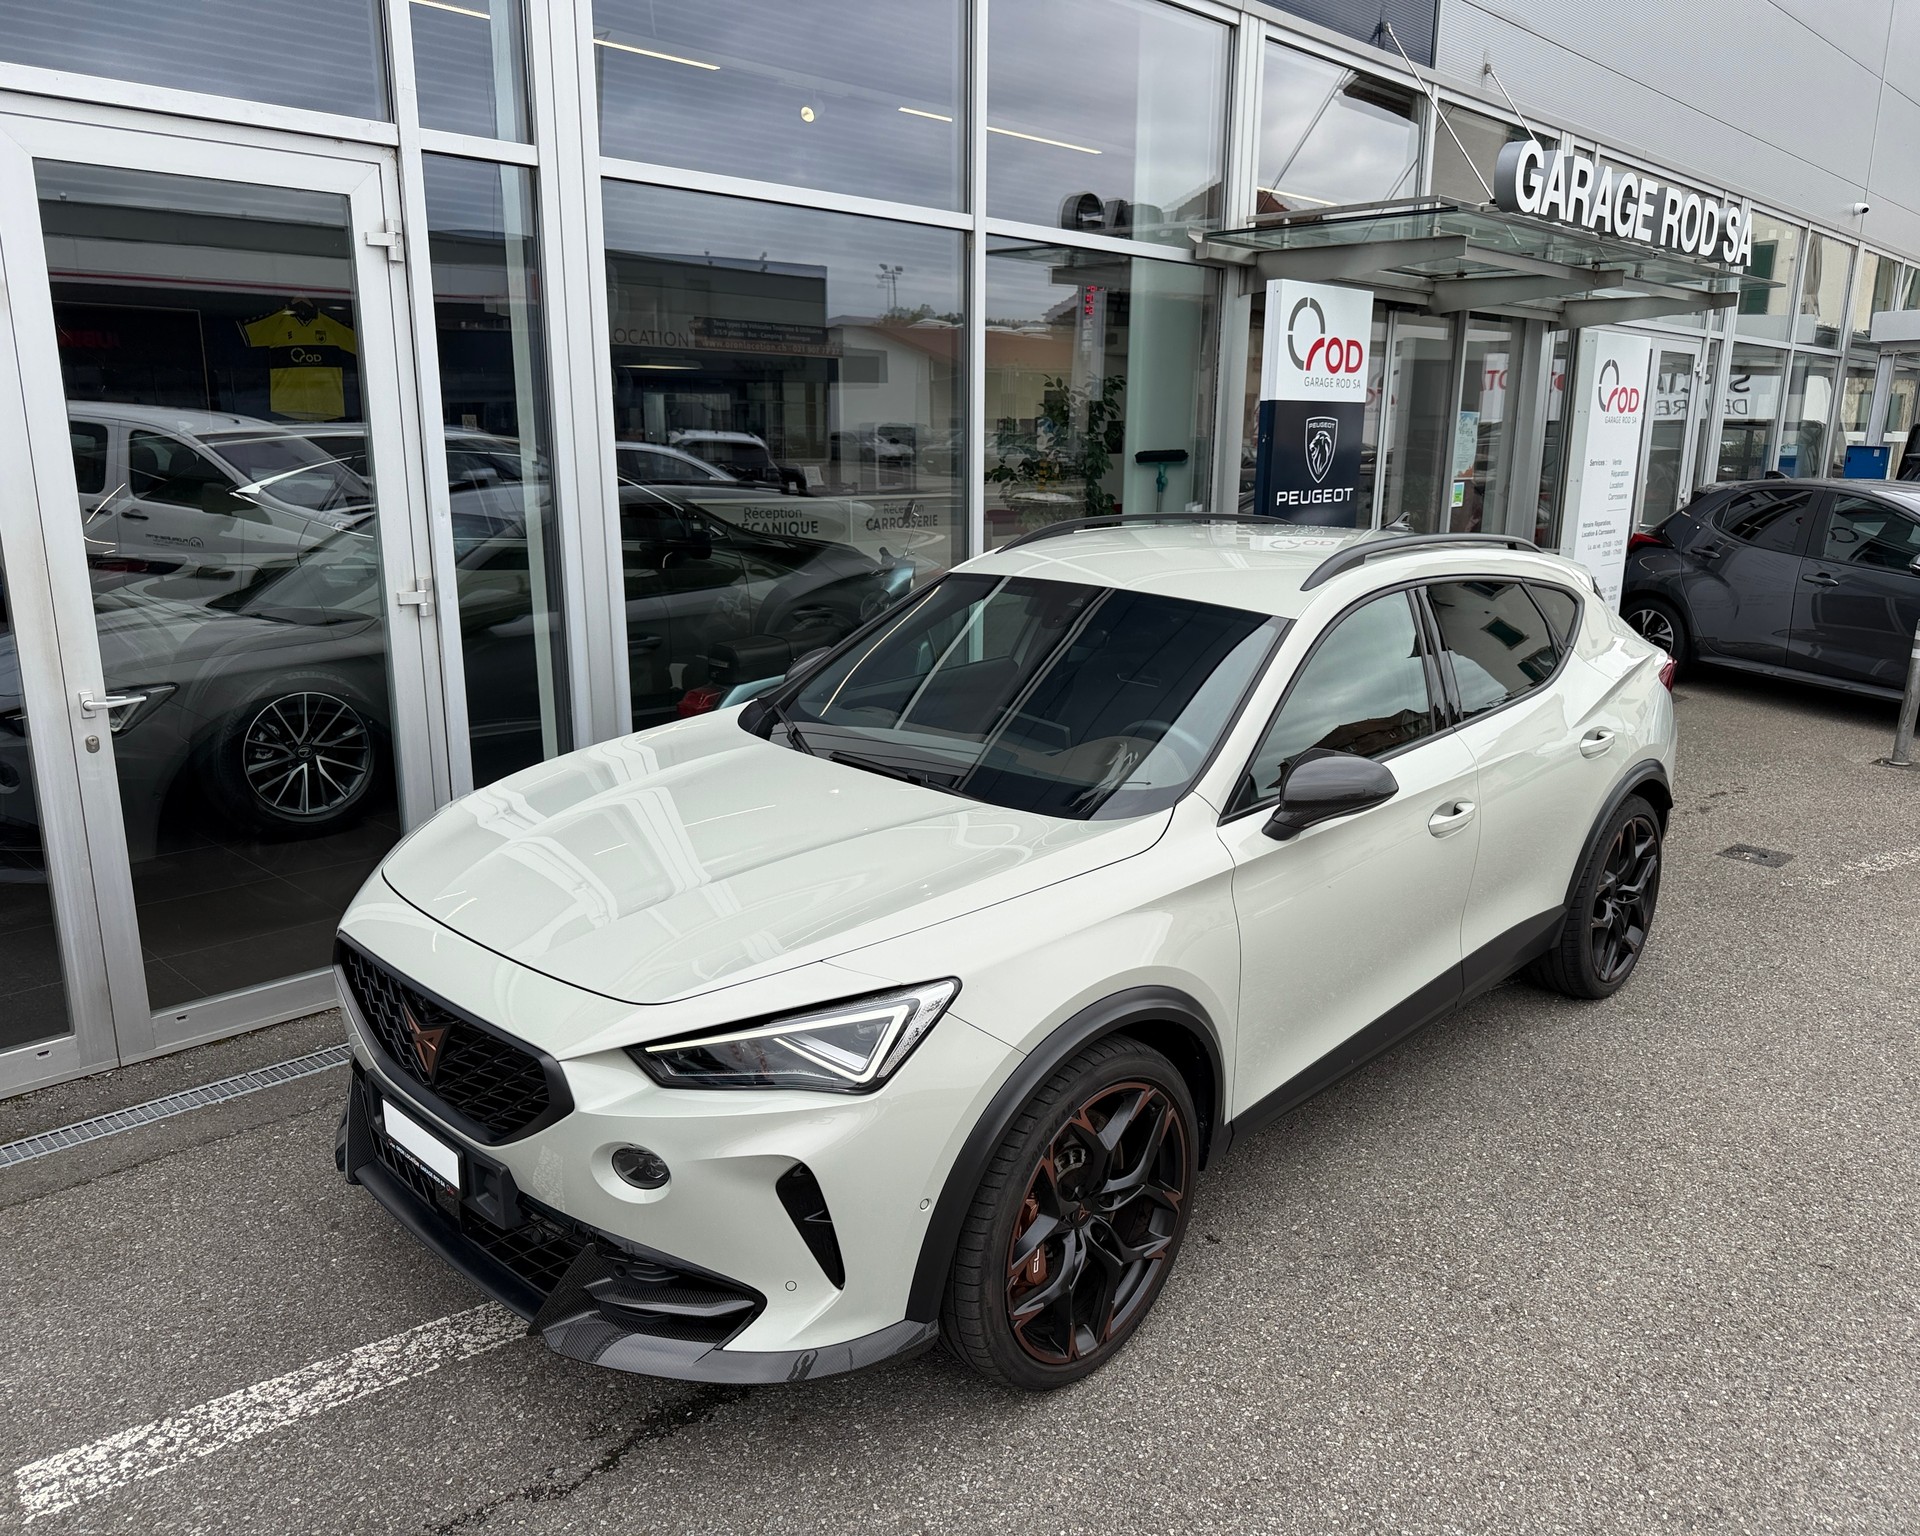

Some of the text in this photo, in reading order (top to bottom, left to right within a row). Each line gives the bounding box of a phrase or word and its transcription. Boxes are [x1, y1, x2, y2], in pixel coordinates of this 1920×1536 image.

[1515, 139, 1753, 267] GARAGE ROD SA
[611, 328, 689, 348] OCATION
[1304, 376, 1361, 389] GARAGE ROD SA
[1308, 421, 1336, 429] PEUGEOT
[1276, 487, 1353, 506] PEUGEOT
[744, 506, 802, 521] Réception
[883, 503, 924, 515] Réceon
